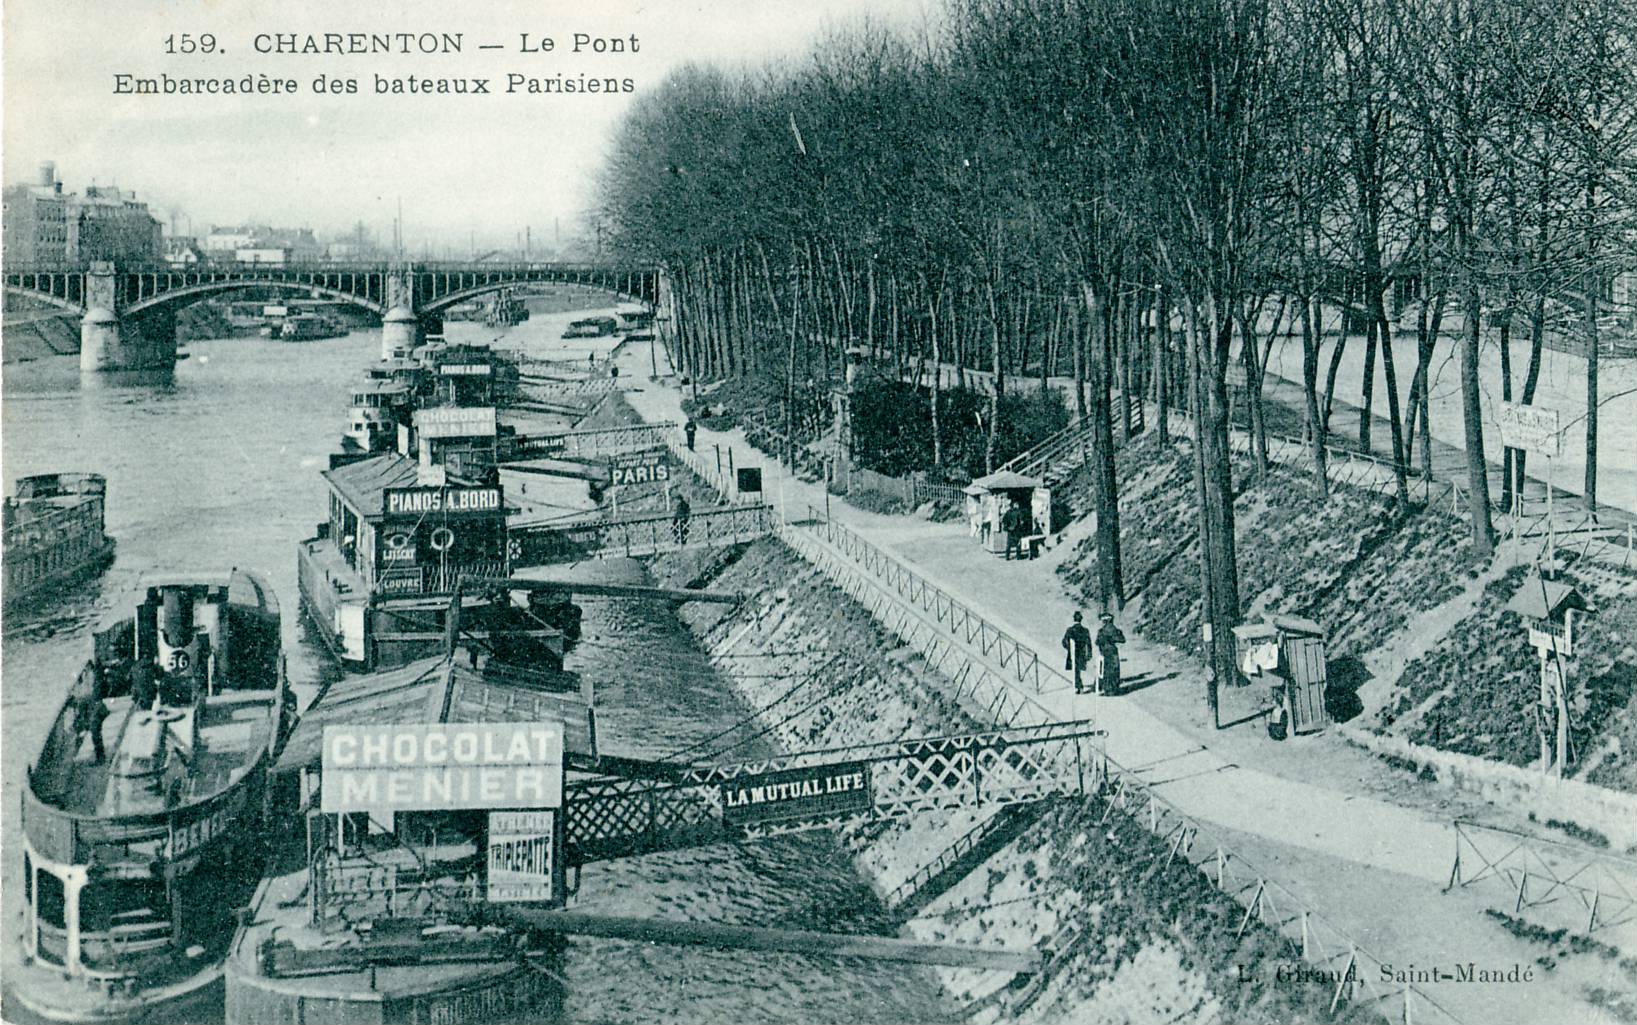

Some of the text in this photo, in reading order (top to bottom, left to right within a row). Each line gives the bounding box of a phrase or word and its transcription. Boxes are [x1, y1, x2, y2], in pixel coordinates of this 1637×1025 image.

[421, 410, 493, 423] CHOCOLAT
[612, 464, 668, 485] PARIS
[389, 492, 441, 512] PIANOS
[384, 577, 419, 589] LOUVRE
[168, 653, 188, 669] 56
[330, 729, 555, 765] CHOCOLAT
[343, 769, 544, 803] MENIER
[726, 773, 863, 805] LA MUTUAL LIFE
